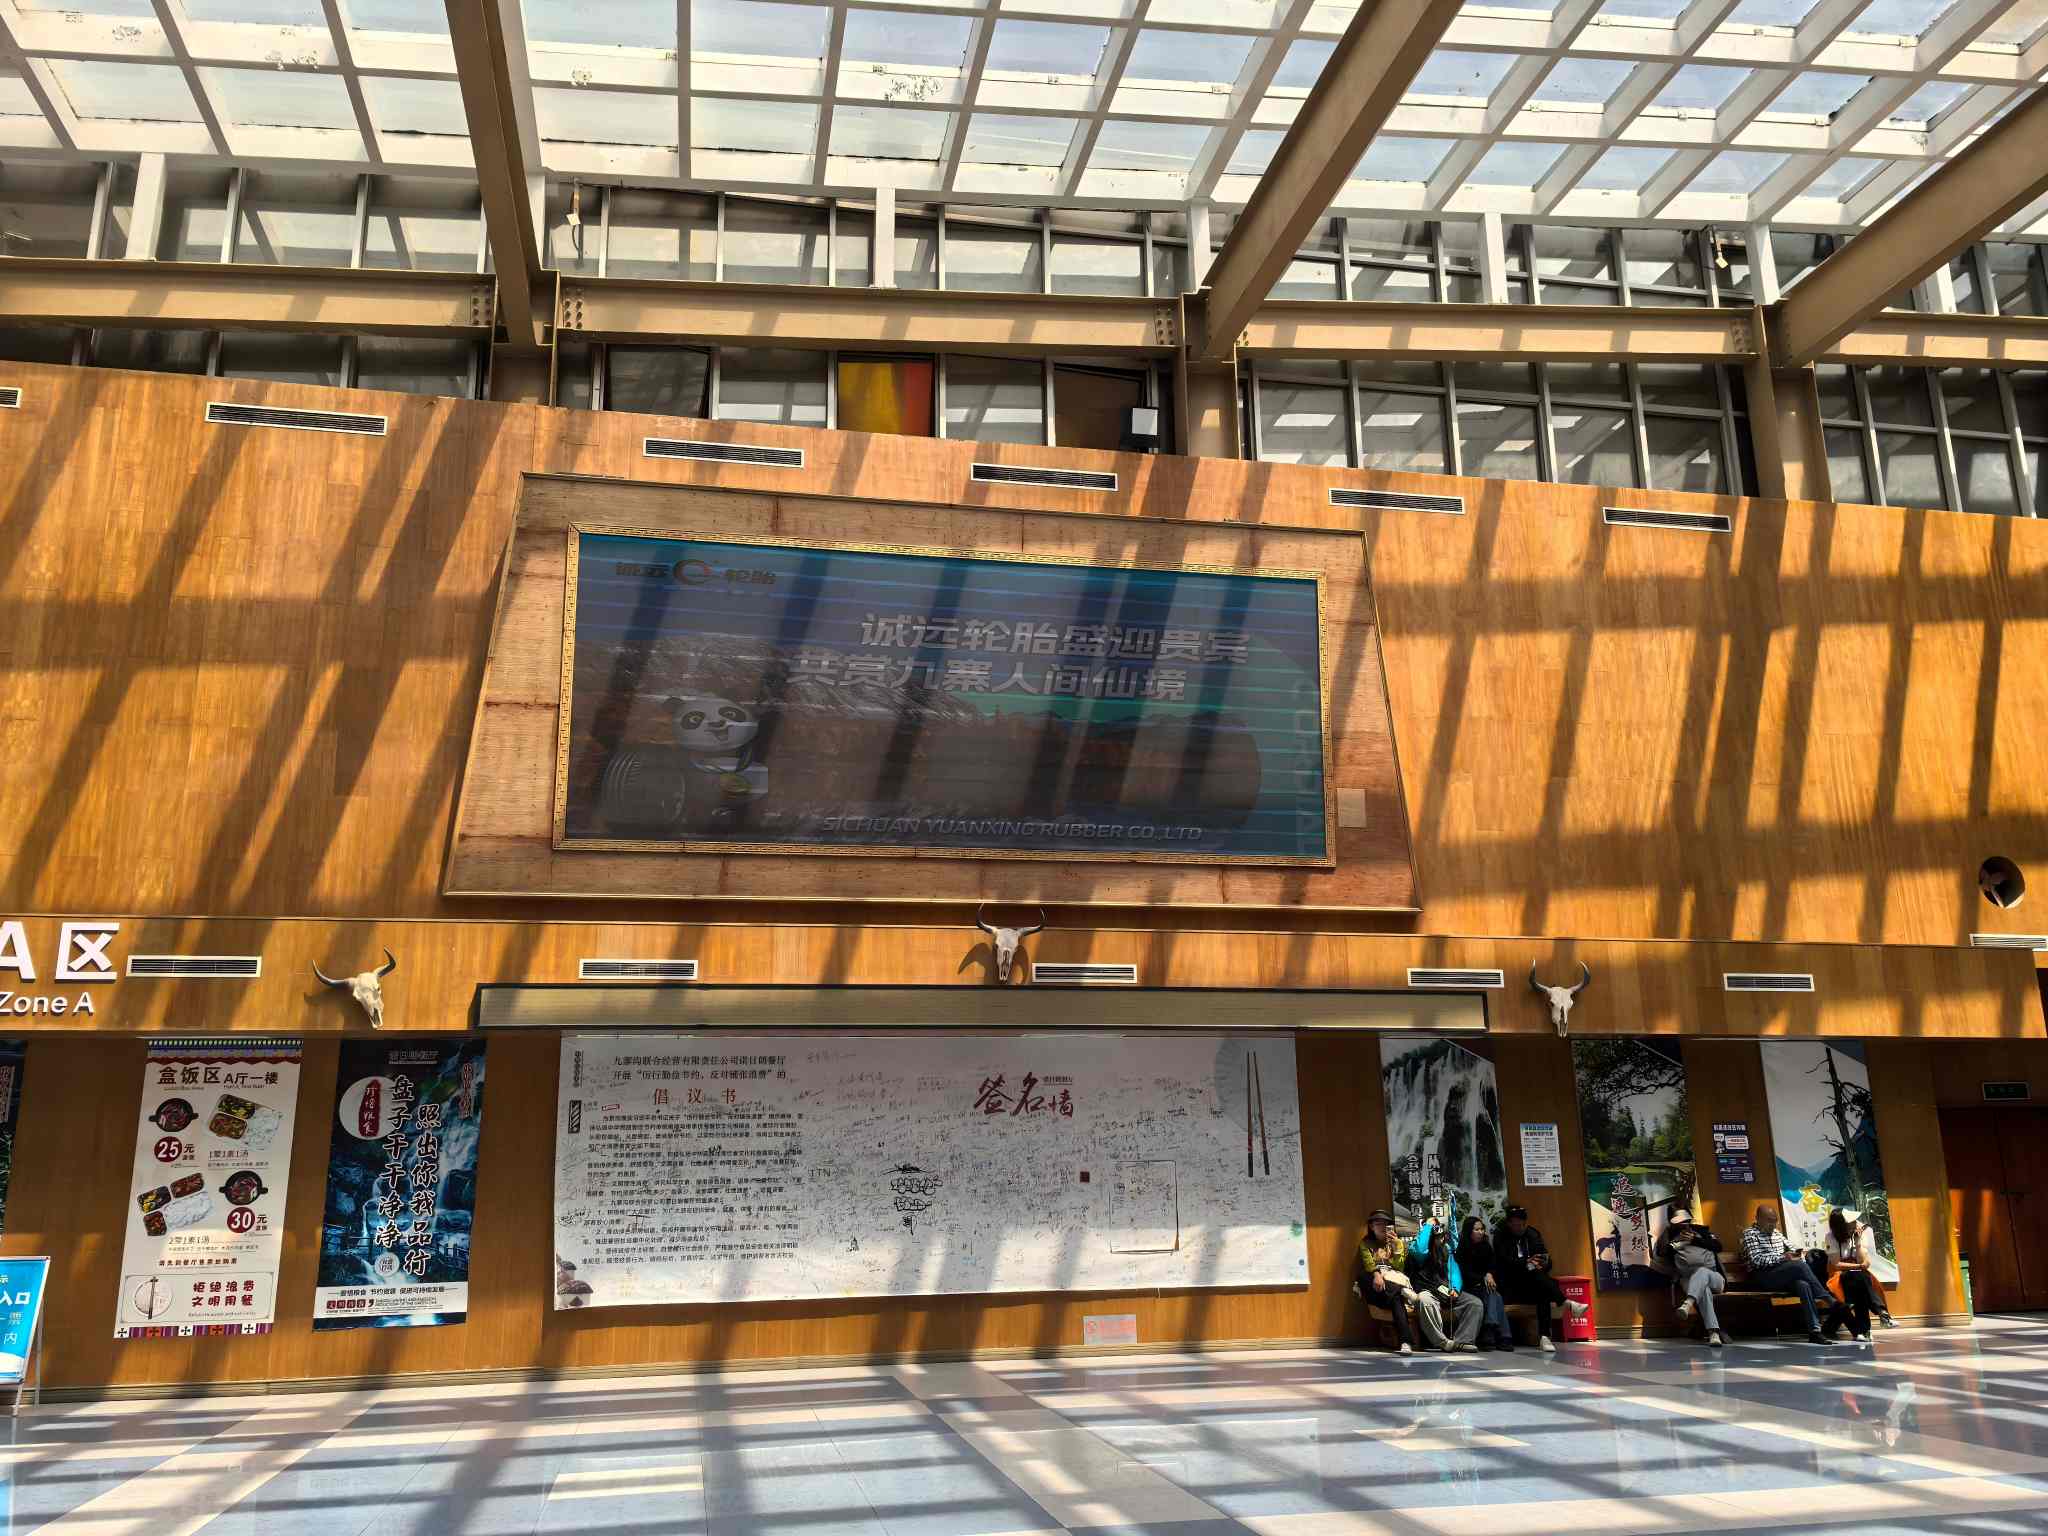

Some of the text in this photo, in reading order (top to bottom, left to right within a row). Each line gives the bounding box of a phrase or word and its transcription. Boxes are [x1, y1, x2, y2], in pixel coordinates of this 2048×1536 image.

[0, 991, 94, 1014] Zone A
[158, 1066, 279, 1085] 盒饭区 A厅一楼
[974, 1072, 1073, 1117] 签名墙
[157, 1141, 180, 1159] 25
[375, 1075, 415, 1248] 盘子干干净净
[403, 1104, 441, 1276] 照出你我品行
[230, 1211, 253, 1229] 30
[191, 1294, 253, 1307] 文明用餐
